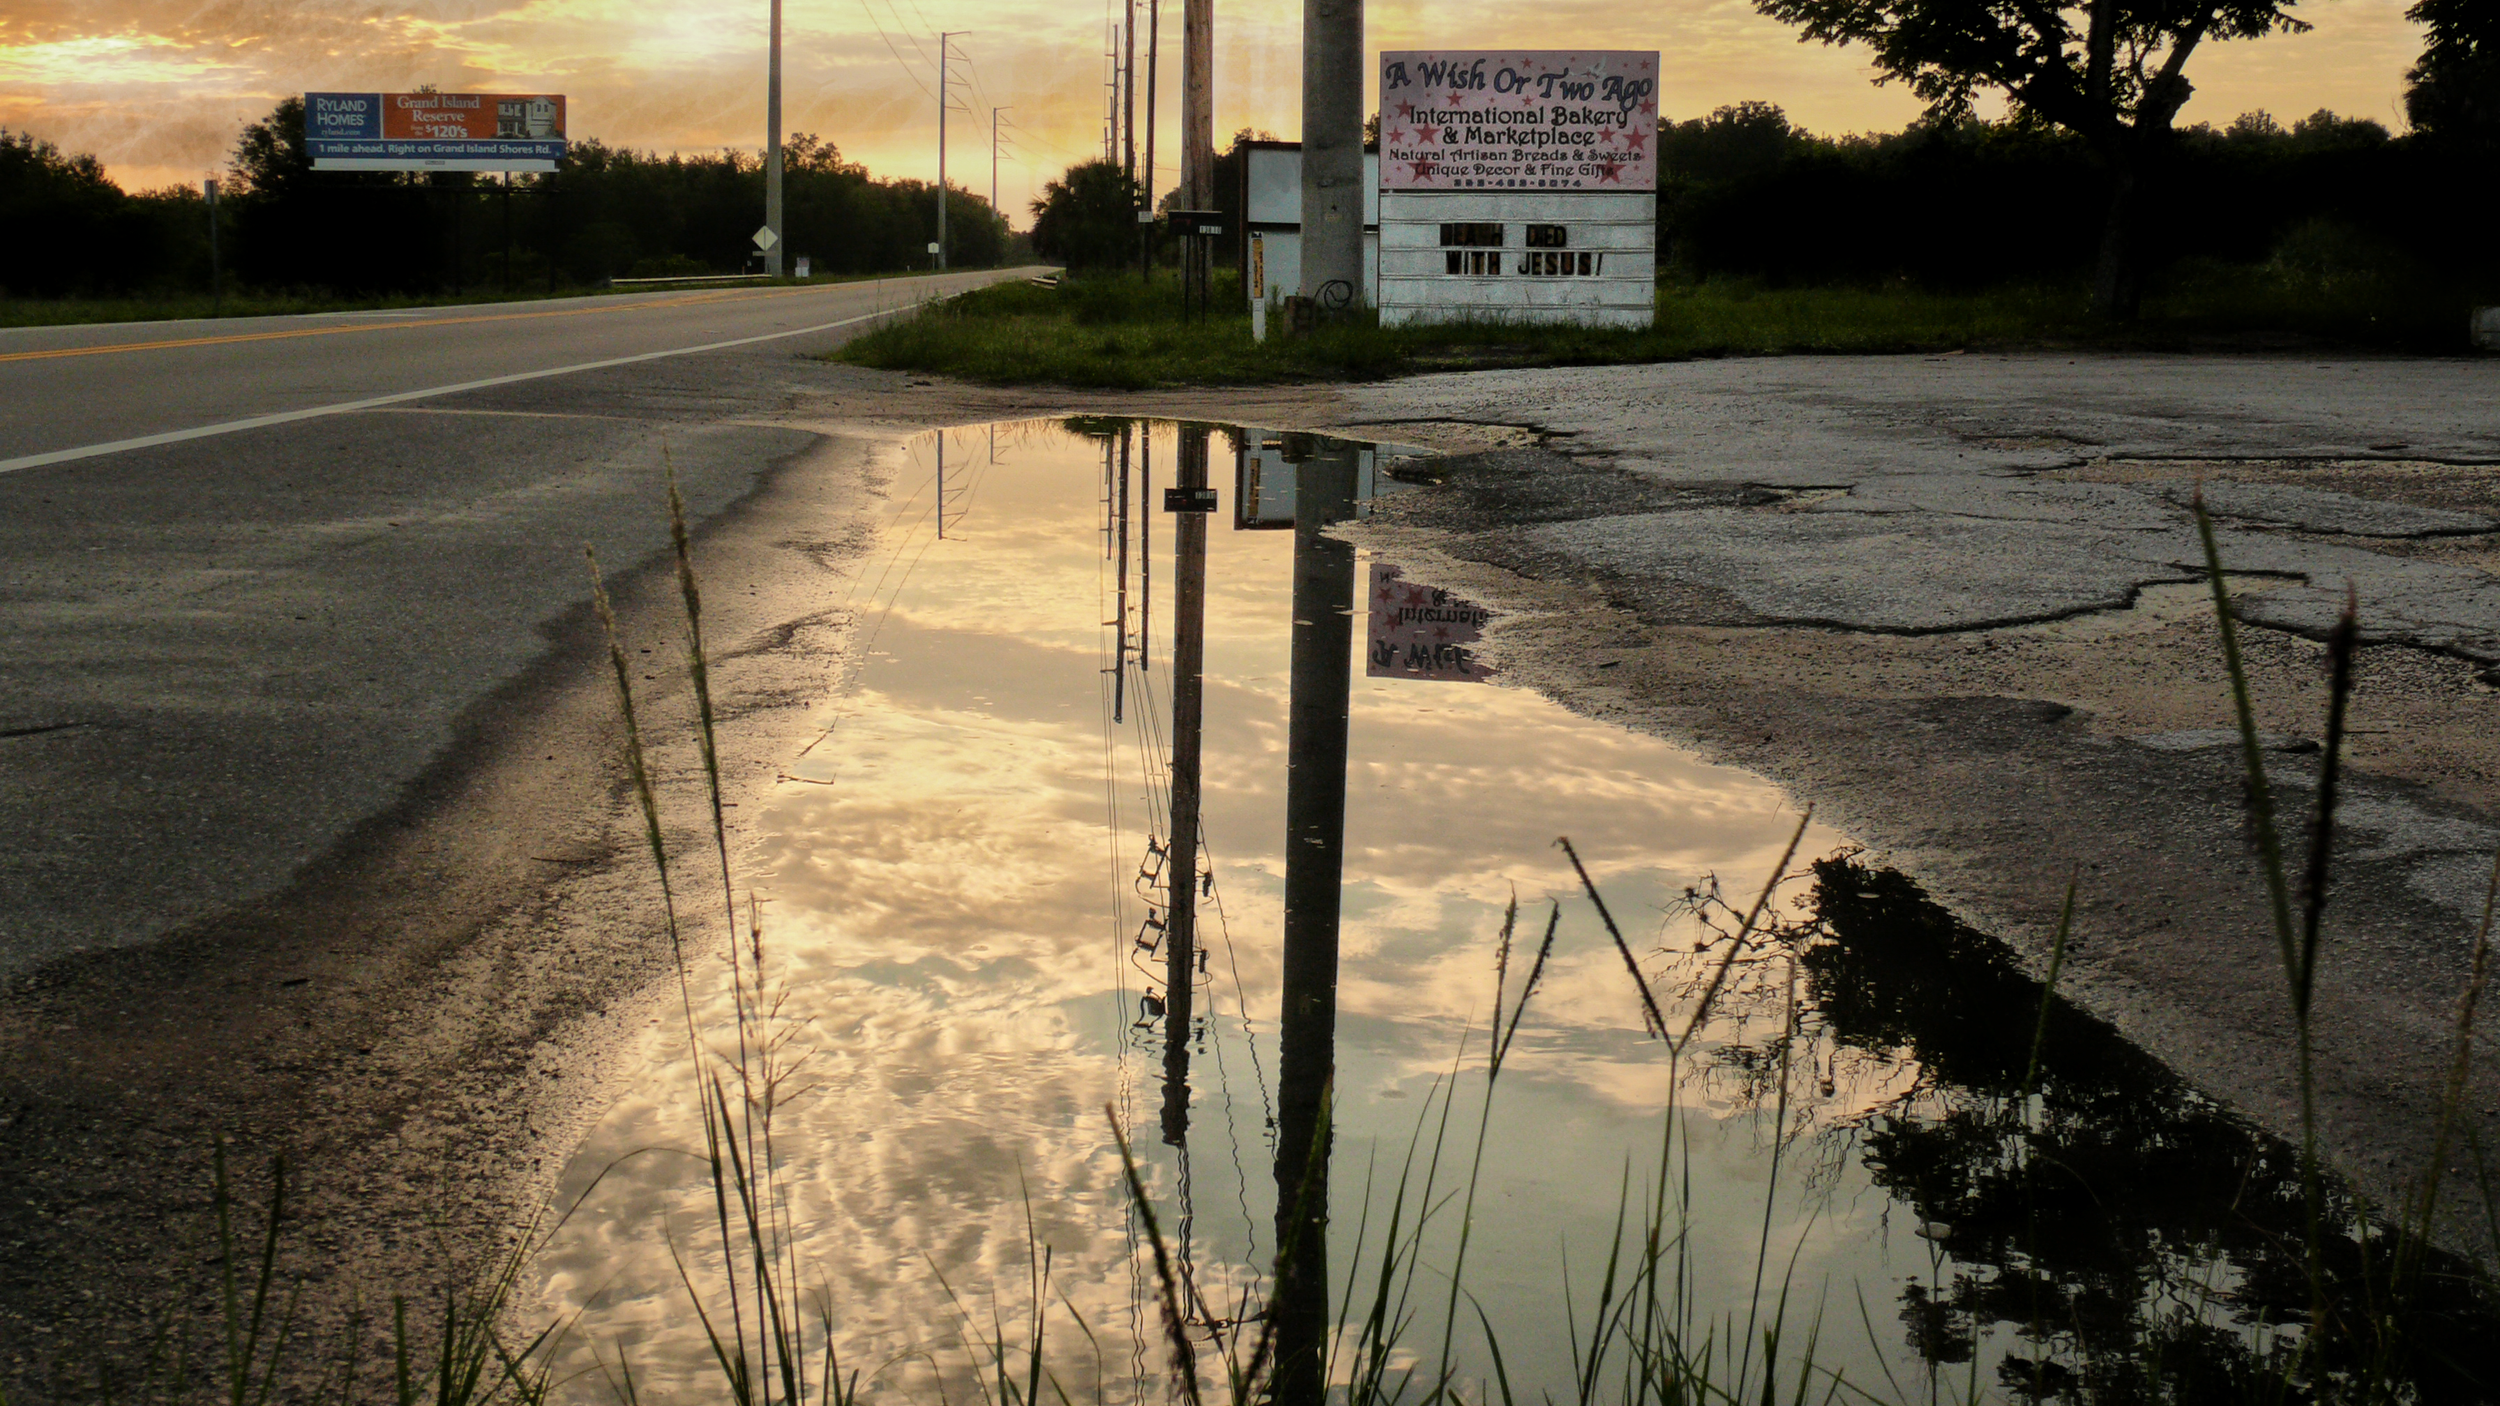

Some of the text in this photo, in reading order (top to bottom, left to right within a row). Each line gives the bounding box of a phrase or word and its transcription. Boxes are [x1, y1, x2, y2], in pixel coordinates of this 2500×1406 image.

[1385, 58, 1653, 112] A Wish Or Two Ago
[316, 97, 367, 112] RYLAND
[396, 95, 480, 109] Grand Island
[317, 112, 364, 126] HOMES
[412, 109, 465, 122] Reserve
[1409, 106, 1629, 129] International Bakery
[425, 124, 468, 138] $120's
[1442, 126, 1596, 150] & Marketplace
[319, 144, 552, 156] 1 mile ahead. Right on Grand Island Shores Rd.
[1389, 149, 1642, 162] Natural Artisan Breads & Sweets
[1415, 163, 1614, 178] Unique Decor & Fine Gifts
[1445, 250, 1603, 276] WITH JESUS!
